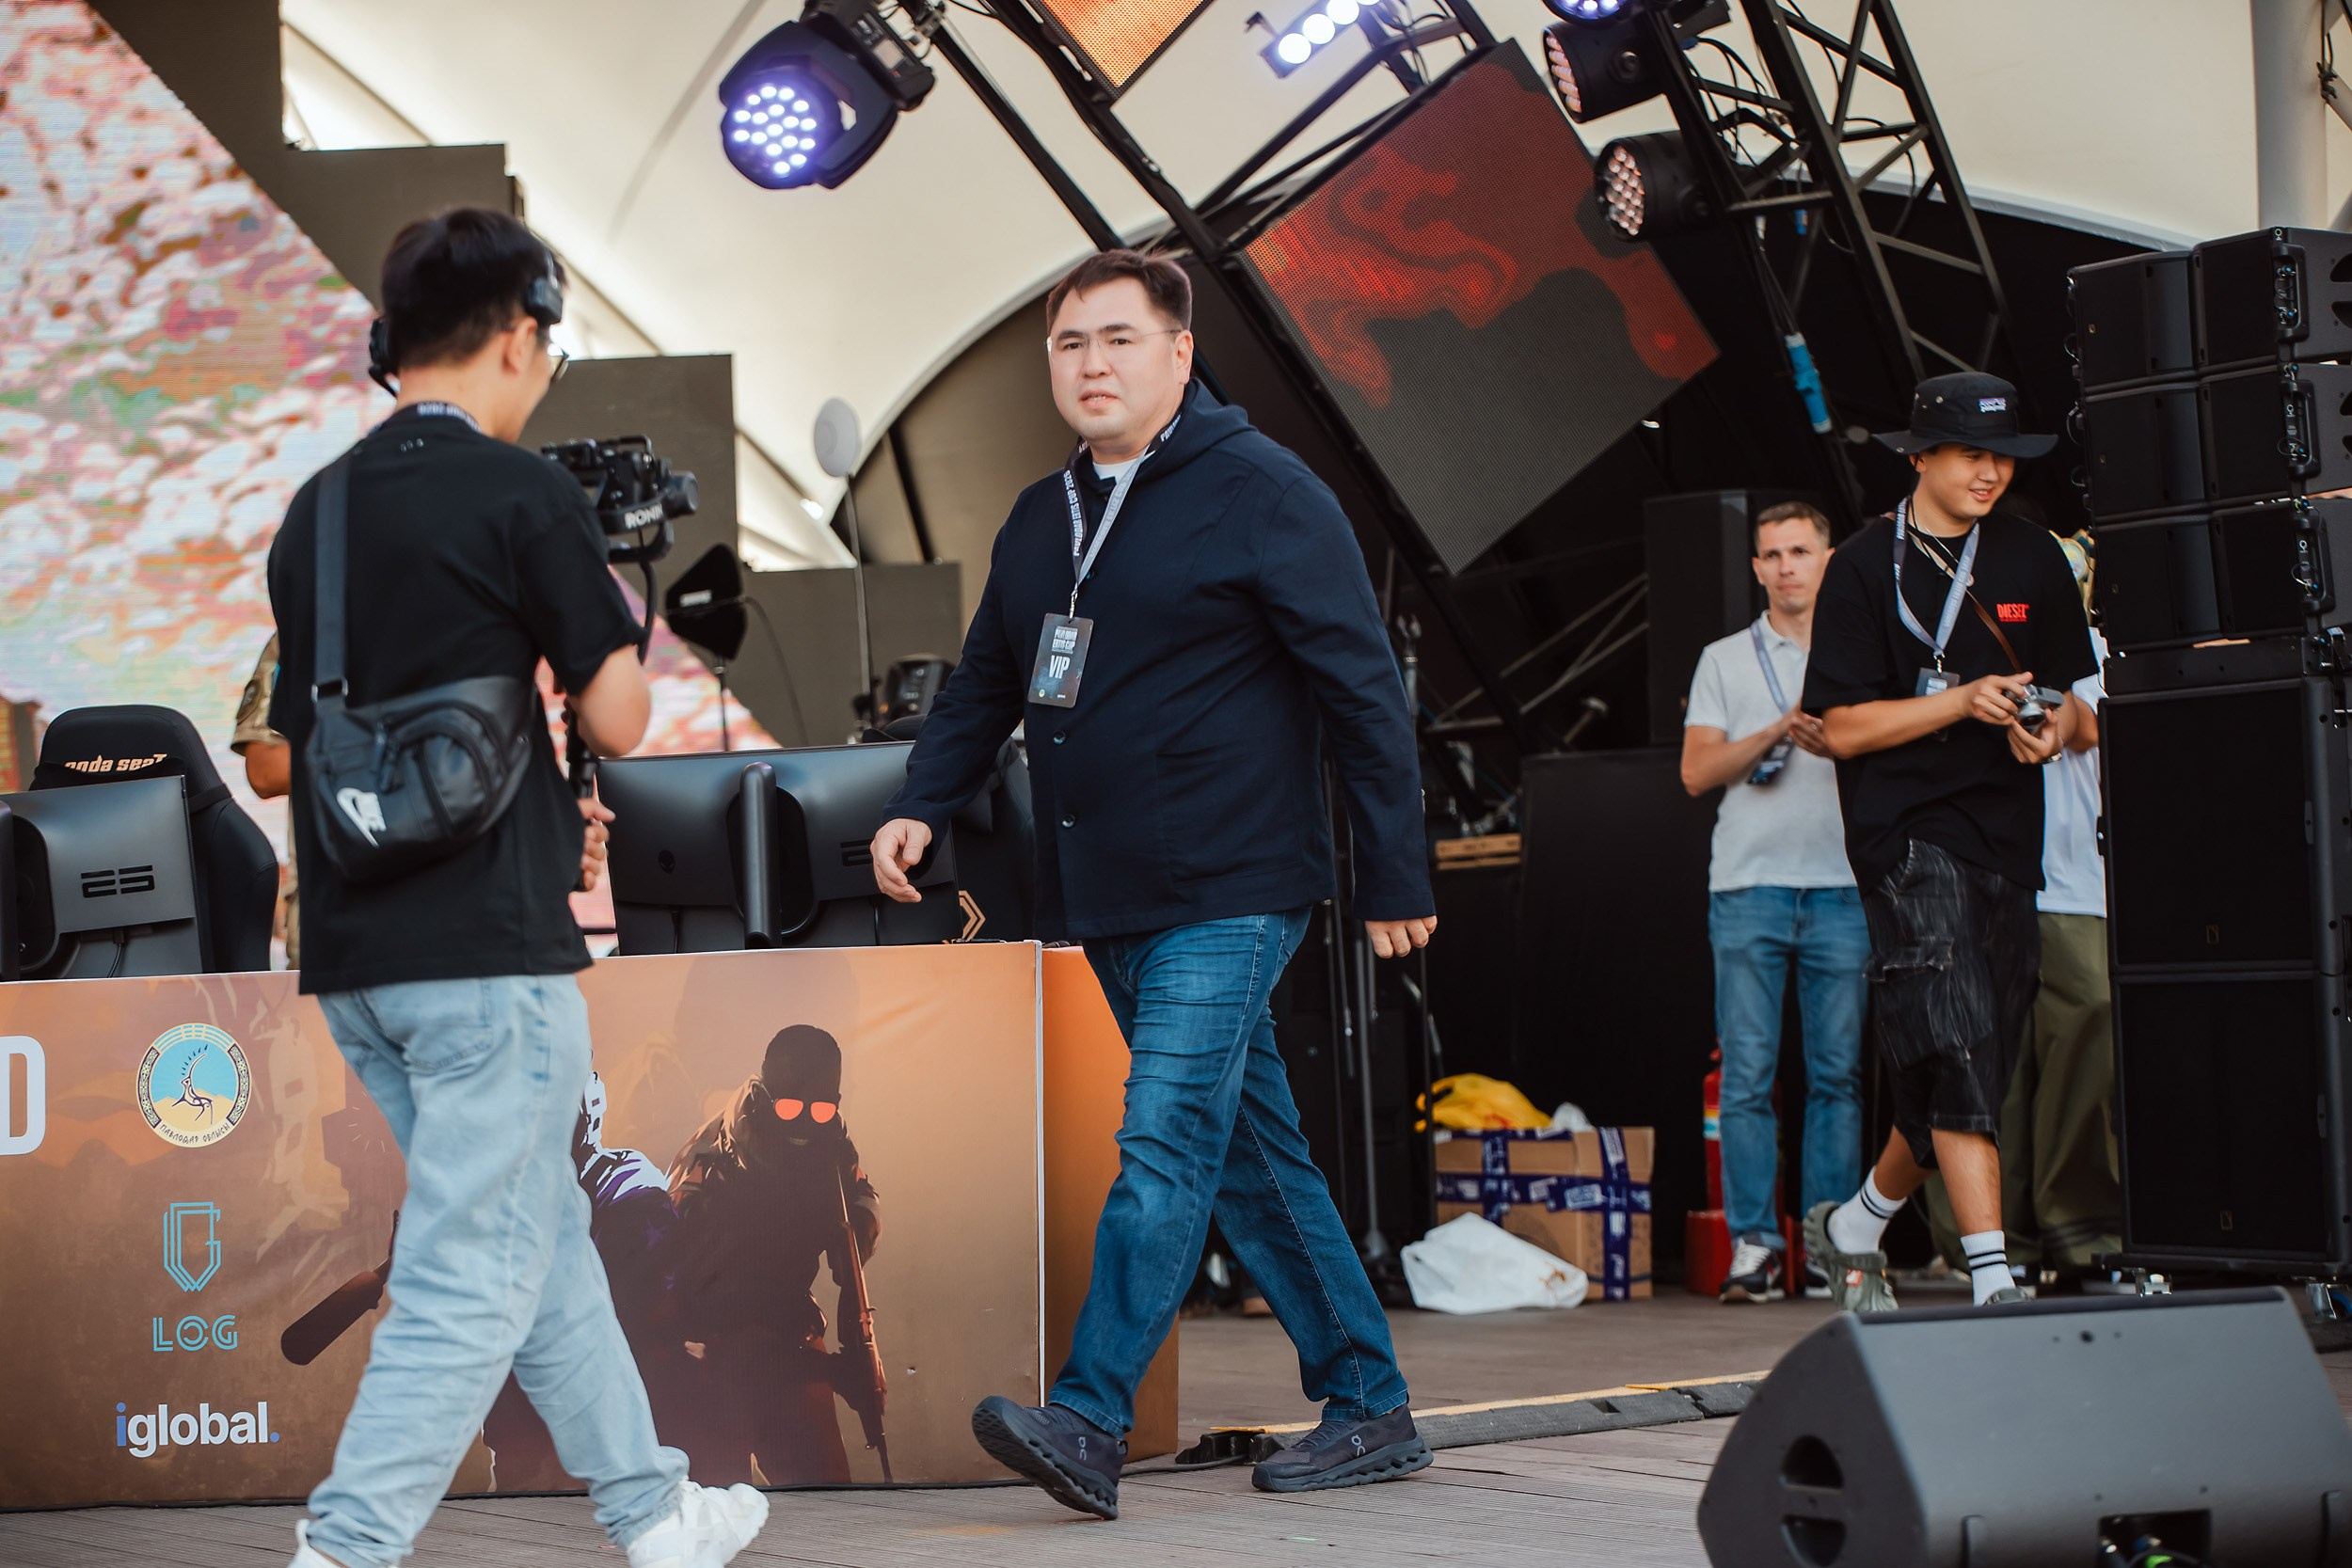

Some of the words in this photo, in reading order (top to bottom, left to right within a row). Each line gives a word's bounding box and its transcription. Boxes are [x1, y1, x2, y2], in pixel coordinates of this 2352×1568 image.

[1063, 470, 1073, 489] 2026
[1067, 488, 1078, 504] CUP
[624, 503, 664, 529] RONIN
[1049, 655, 1071, 679] VIP
[152, 1314, 238, 1352] LOG
